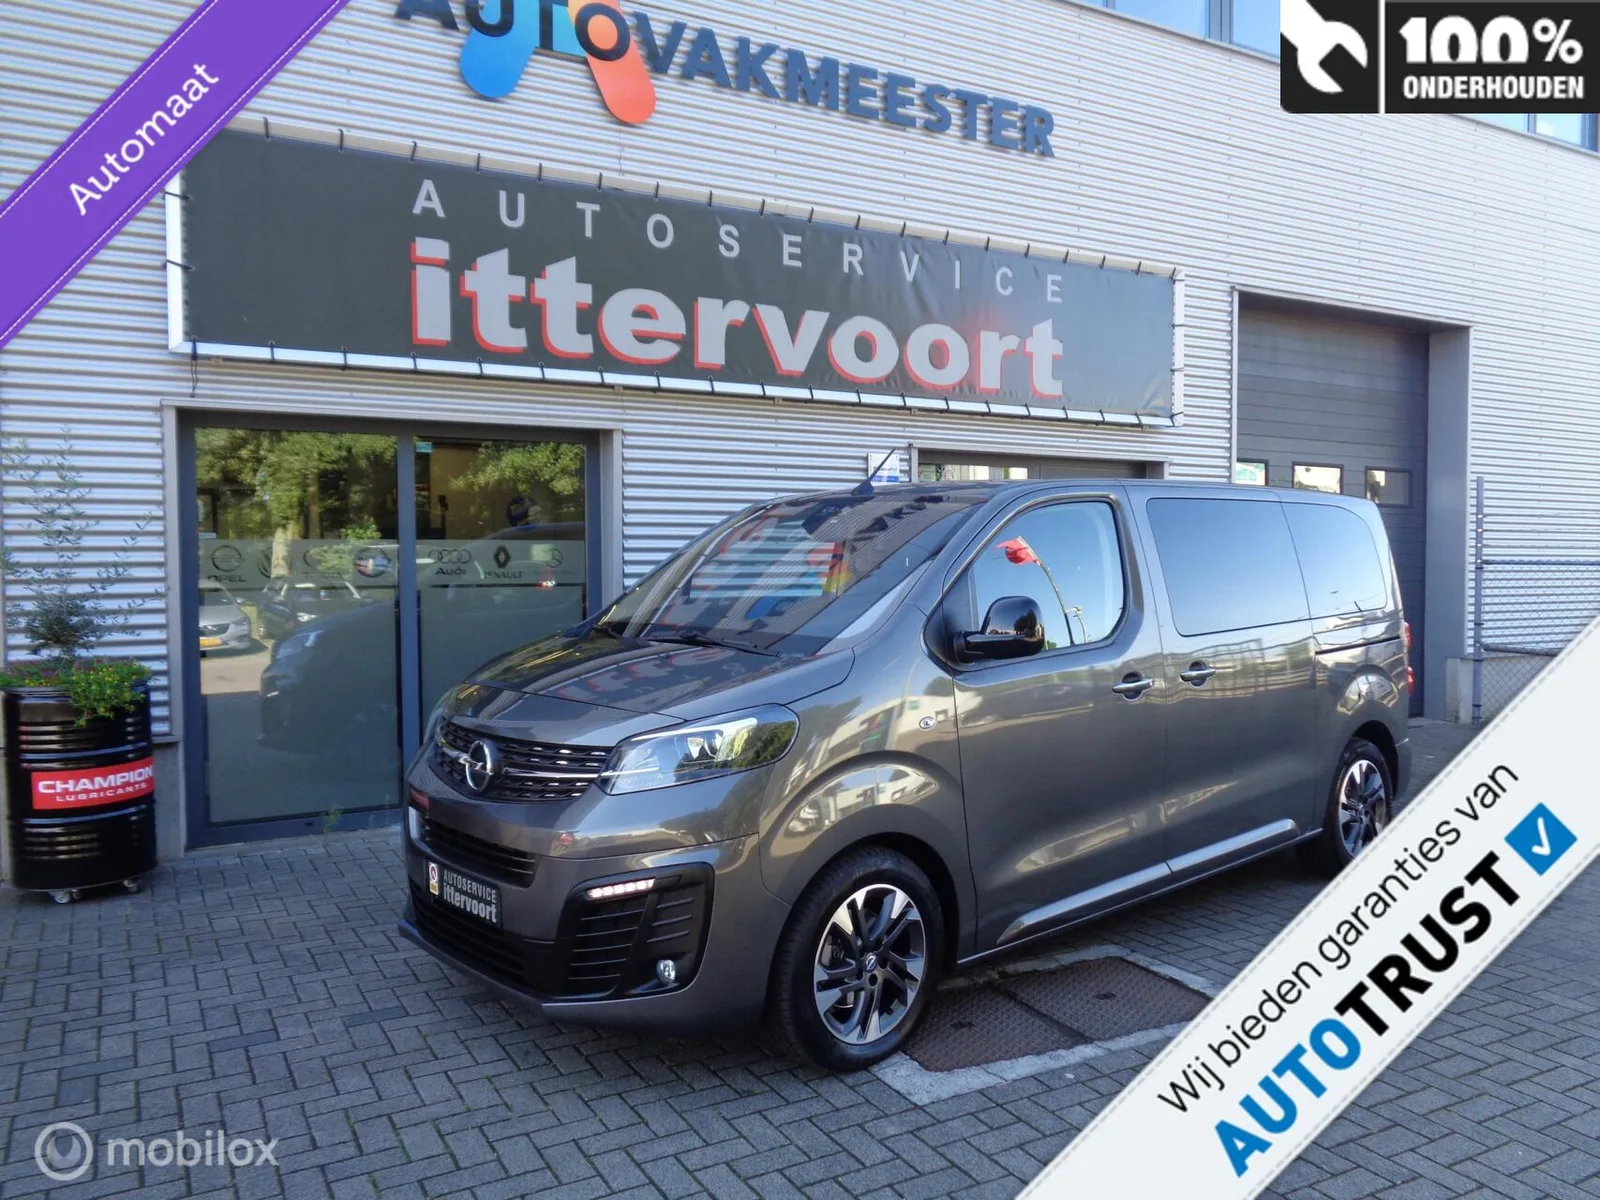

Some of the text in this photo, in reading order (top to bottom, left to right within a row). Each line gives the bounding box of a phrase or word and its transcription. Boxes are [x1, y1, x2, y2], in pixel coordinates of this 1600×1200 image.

[410, 236, 1064, 399] ittervoort
[38, 765, 153, 794] CHAMPION
[56, 782, 148, 802] LUBRICANTS
[443, 869, 497, 903] AUTOSERVICE
[443, 882, 497, 923] ittervoort
